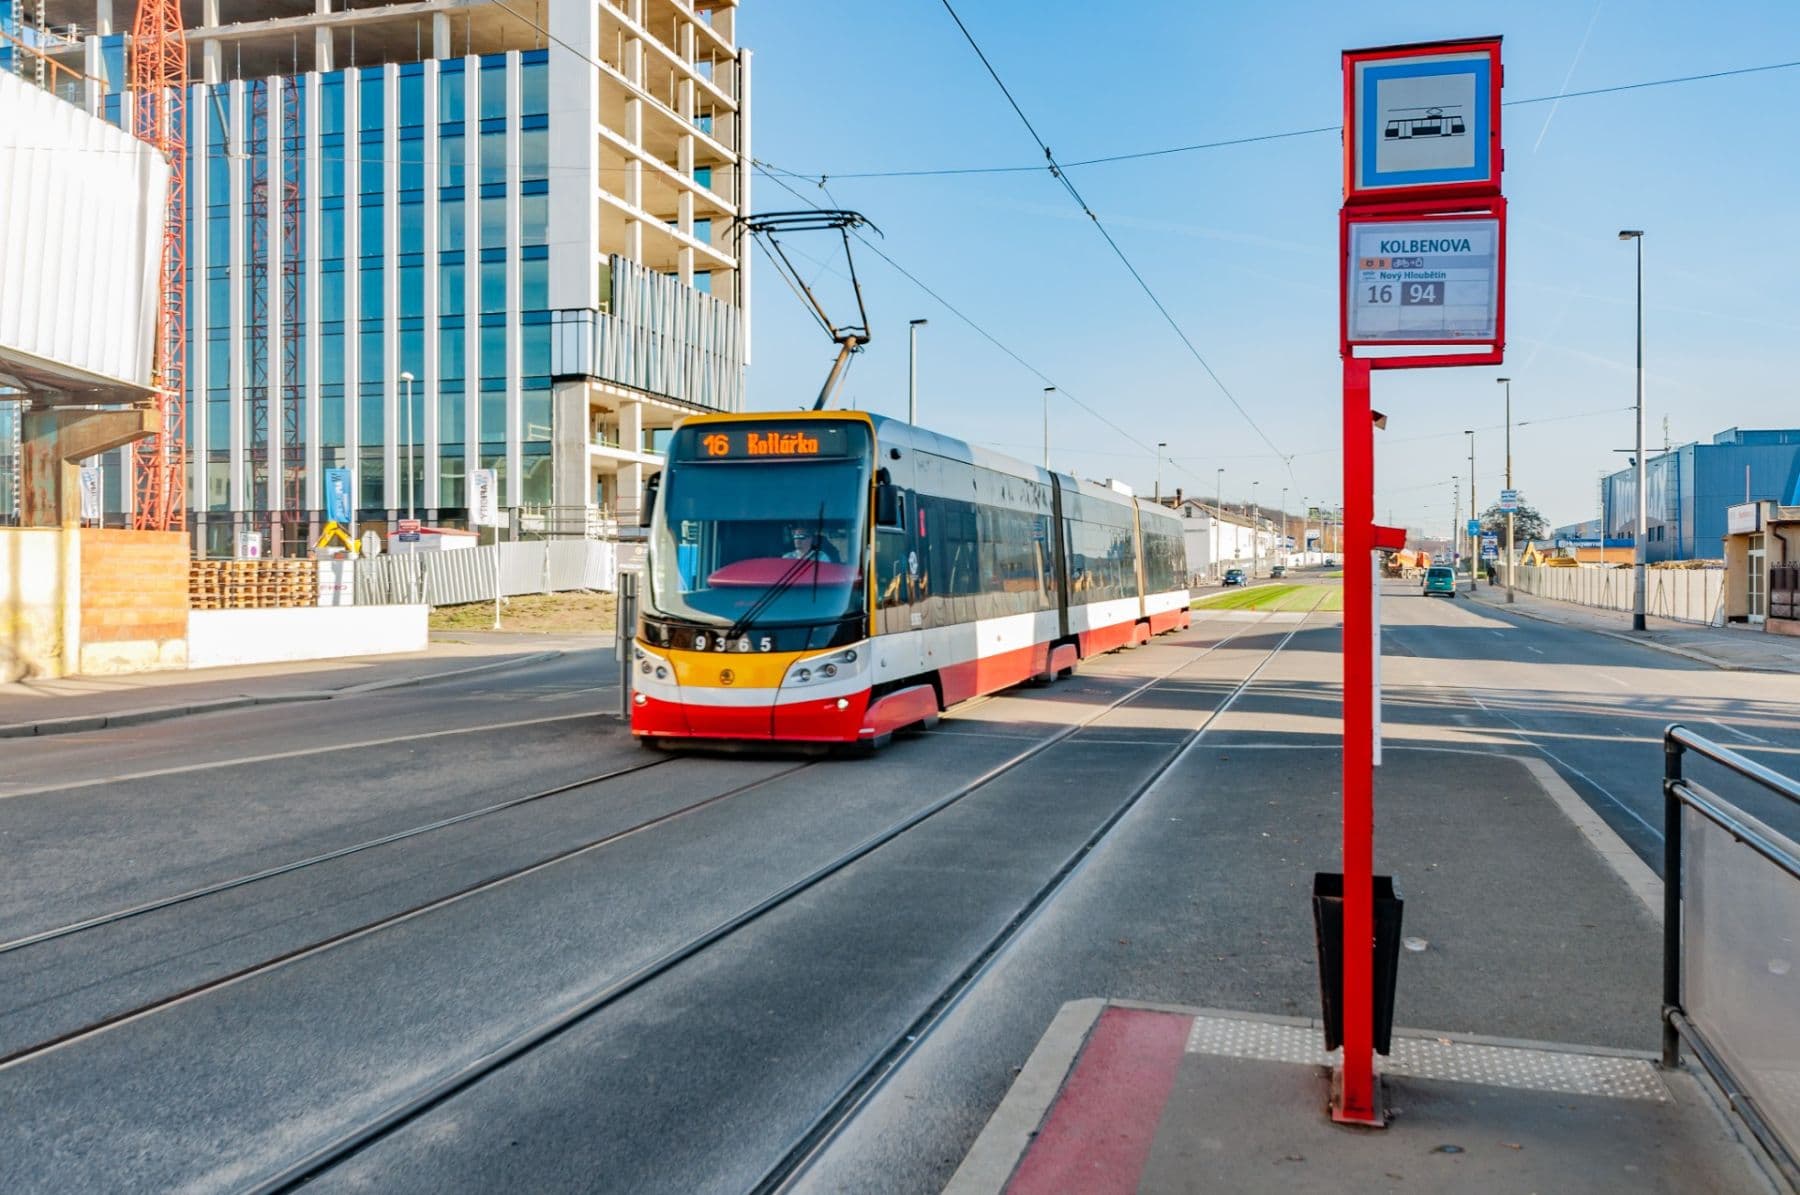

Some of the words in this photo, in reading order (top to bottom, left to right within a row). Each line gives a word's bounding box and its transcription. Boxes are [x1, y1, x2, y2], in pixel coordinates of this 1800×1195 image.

[1380, 239, 1471, 254] KOLBENOVA
[1368, 285, 1392, 303] 16
[1410, 284, 1436, 303] 94
[703, 434, 728, 456] 16
[695, 635, 772, 652] 9365
